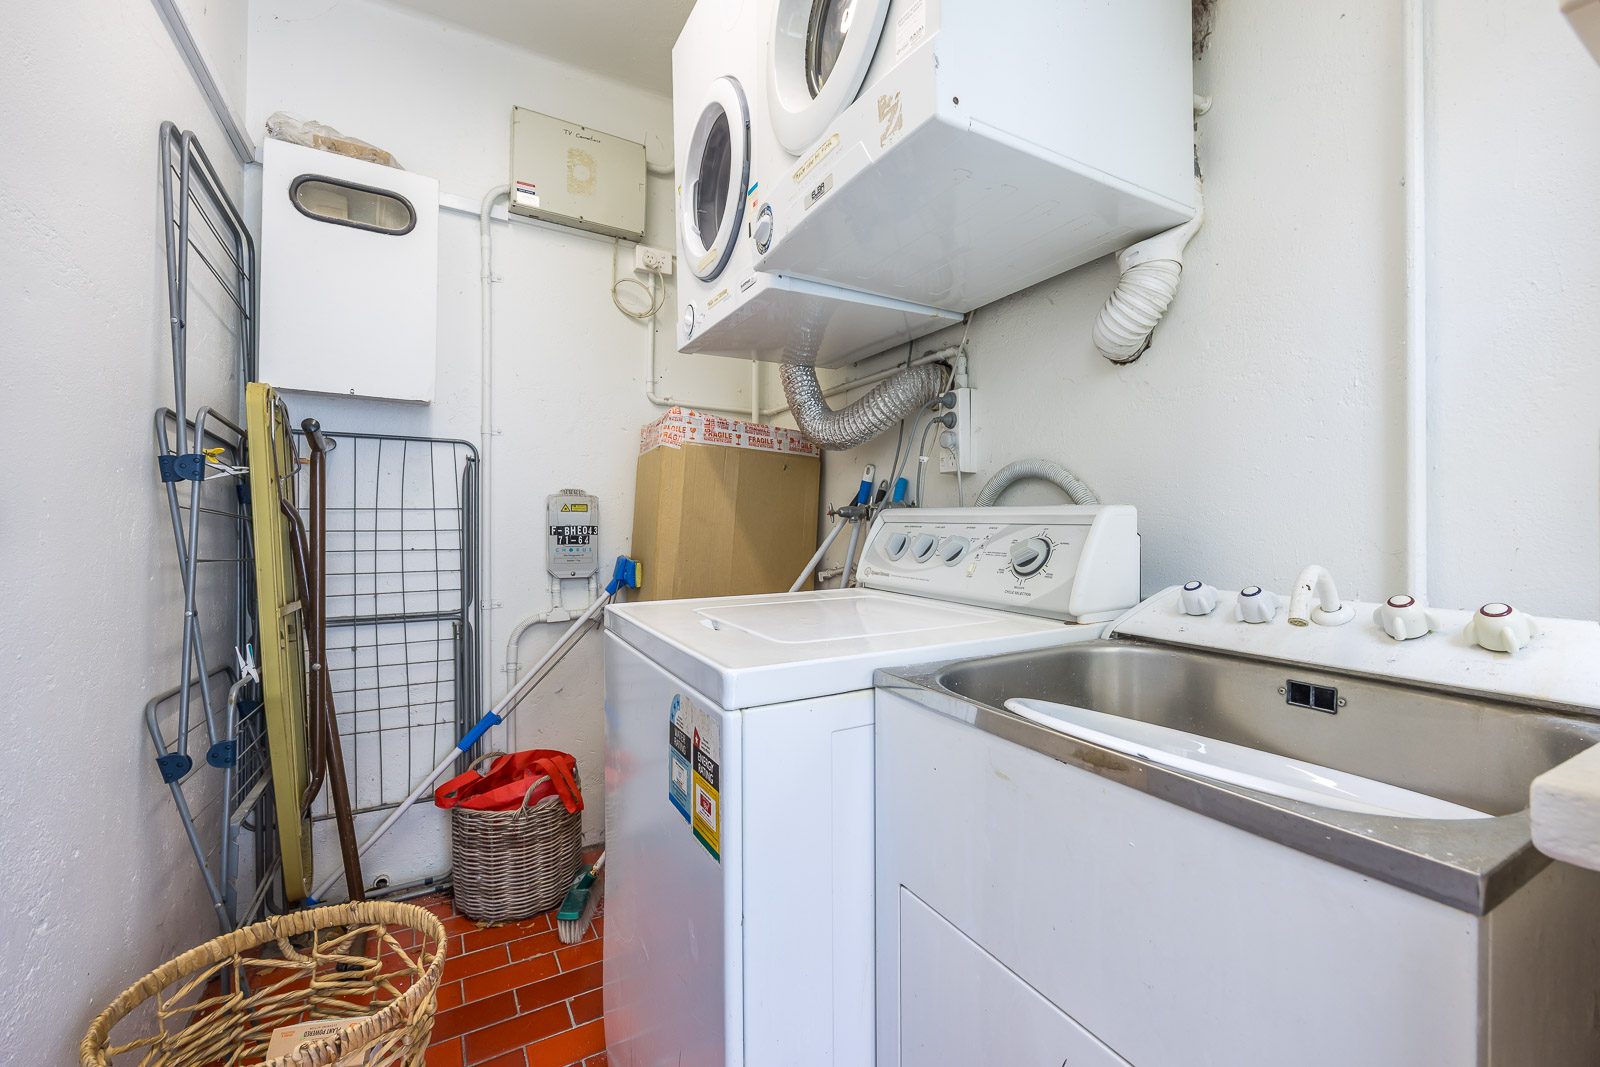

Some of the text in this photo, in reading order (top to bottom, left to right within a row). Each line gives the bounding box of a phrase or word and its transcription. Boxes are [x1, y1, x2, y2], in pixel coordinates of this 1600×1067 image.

[748, 435, 774, 445] FRAGILE
[558, 535, 589, 544] 71-64
[697, 751, 715, 773] ENERGY
[697, 763, 714, 785] RATING
[303, 1029, 326, 1038] POWERED
